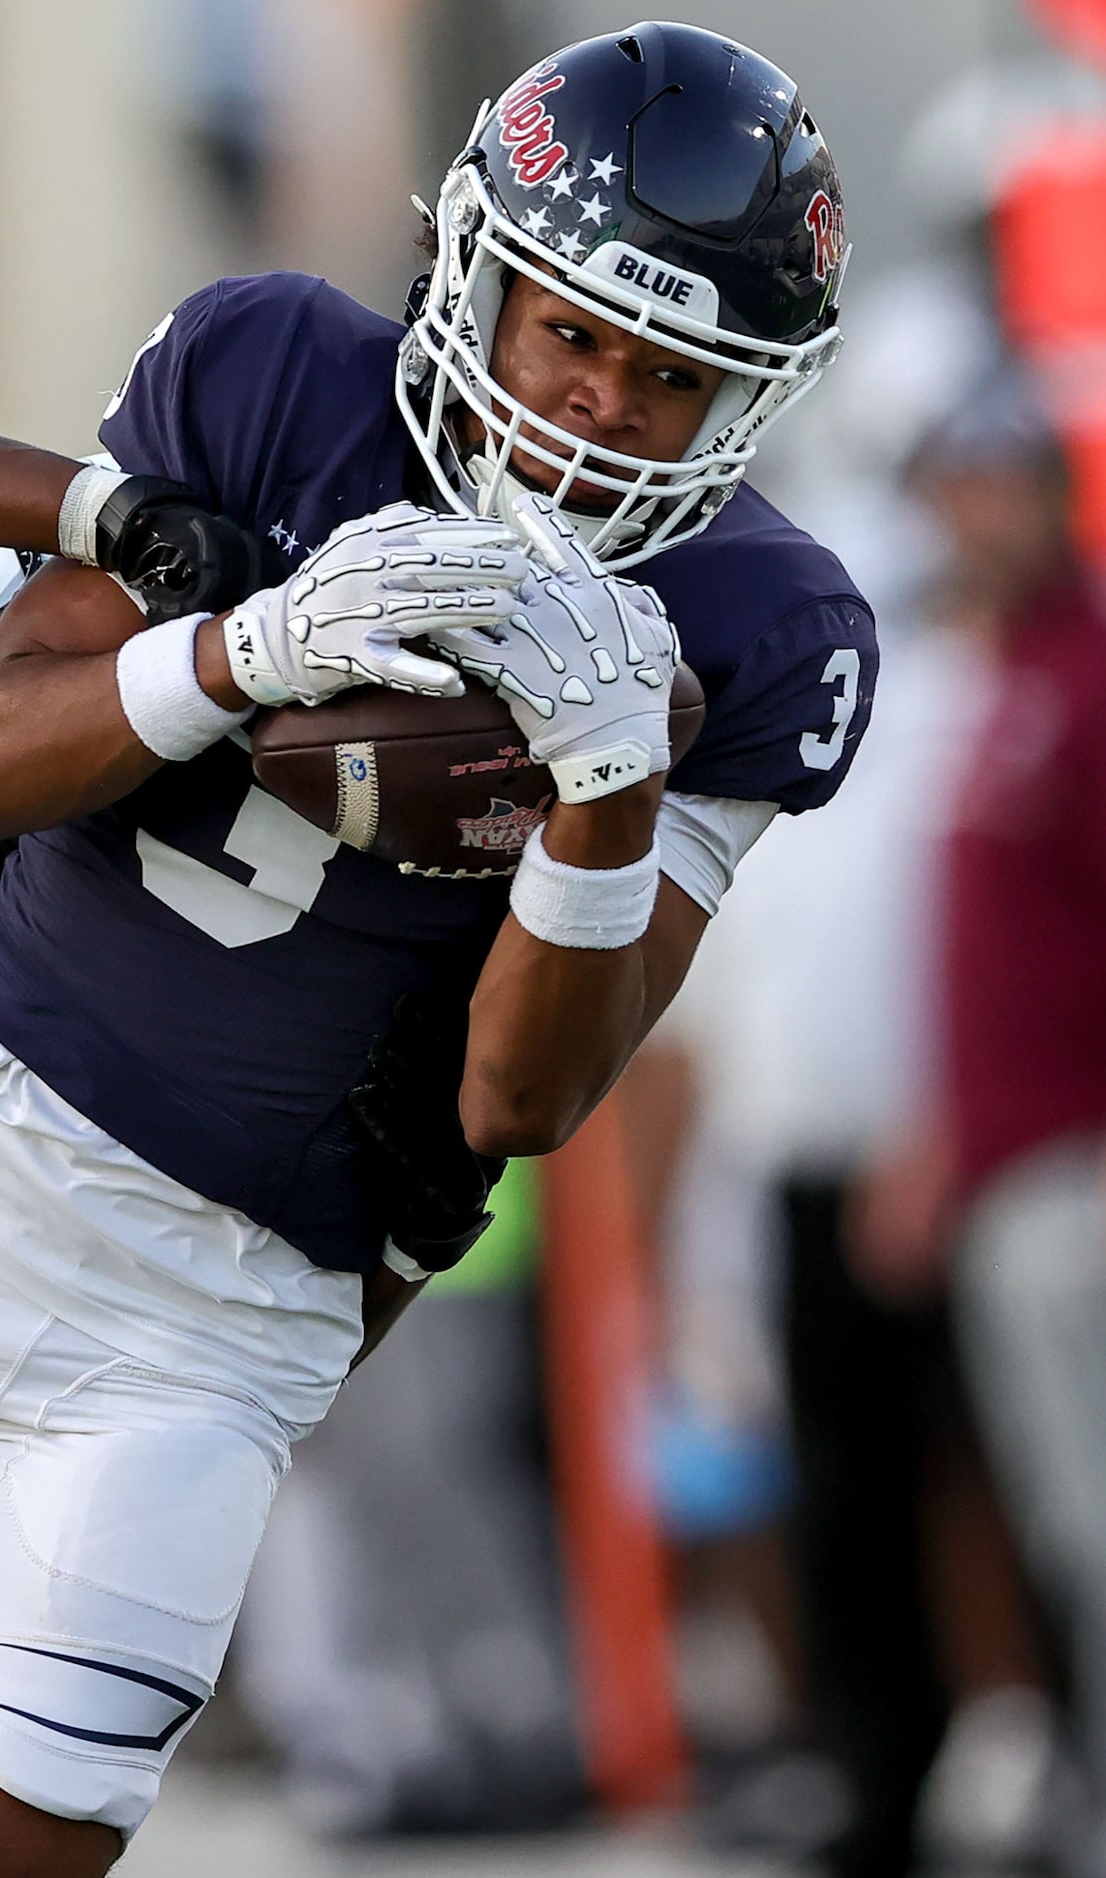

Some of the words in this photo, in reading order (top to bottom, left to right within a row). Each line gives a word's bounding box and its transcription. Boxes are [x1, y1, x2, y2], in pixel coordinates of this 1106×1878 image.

[496, 62, 568, 188] iders
[614, 254, 693, 306] BLUE
[798, 648, 861, 772] 3
[459, 827, 533, 848] YAN
